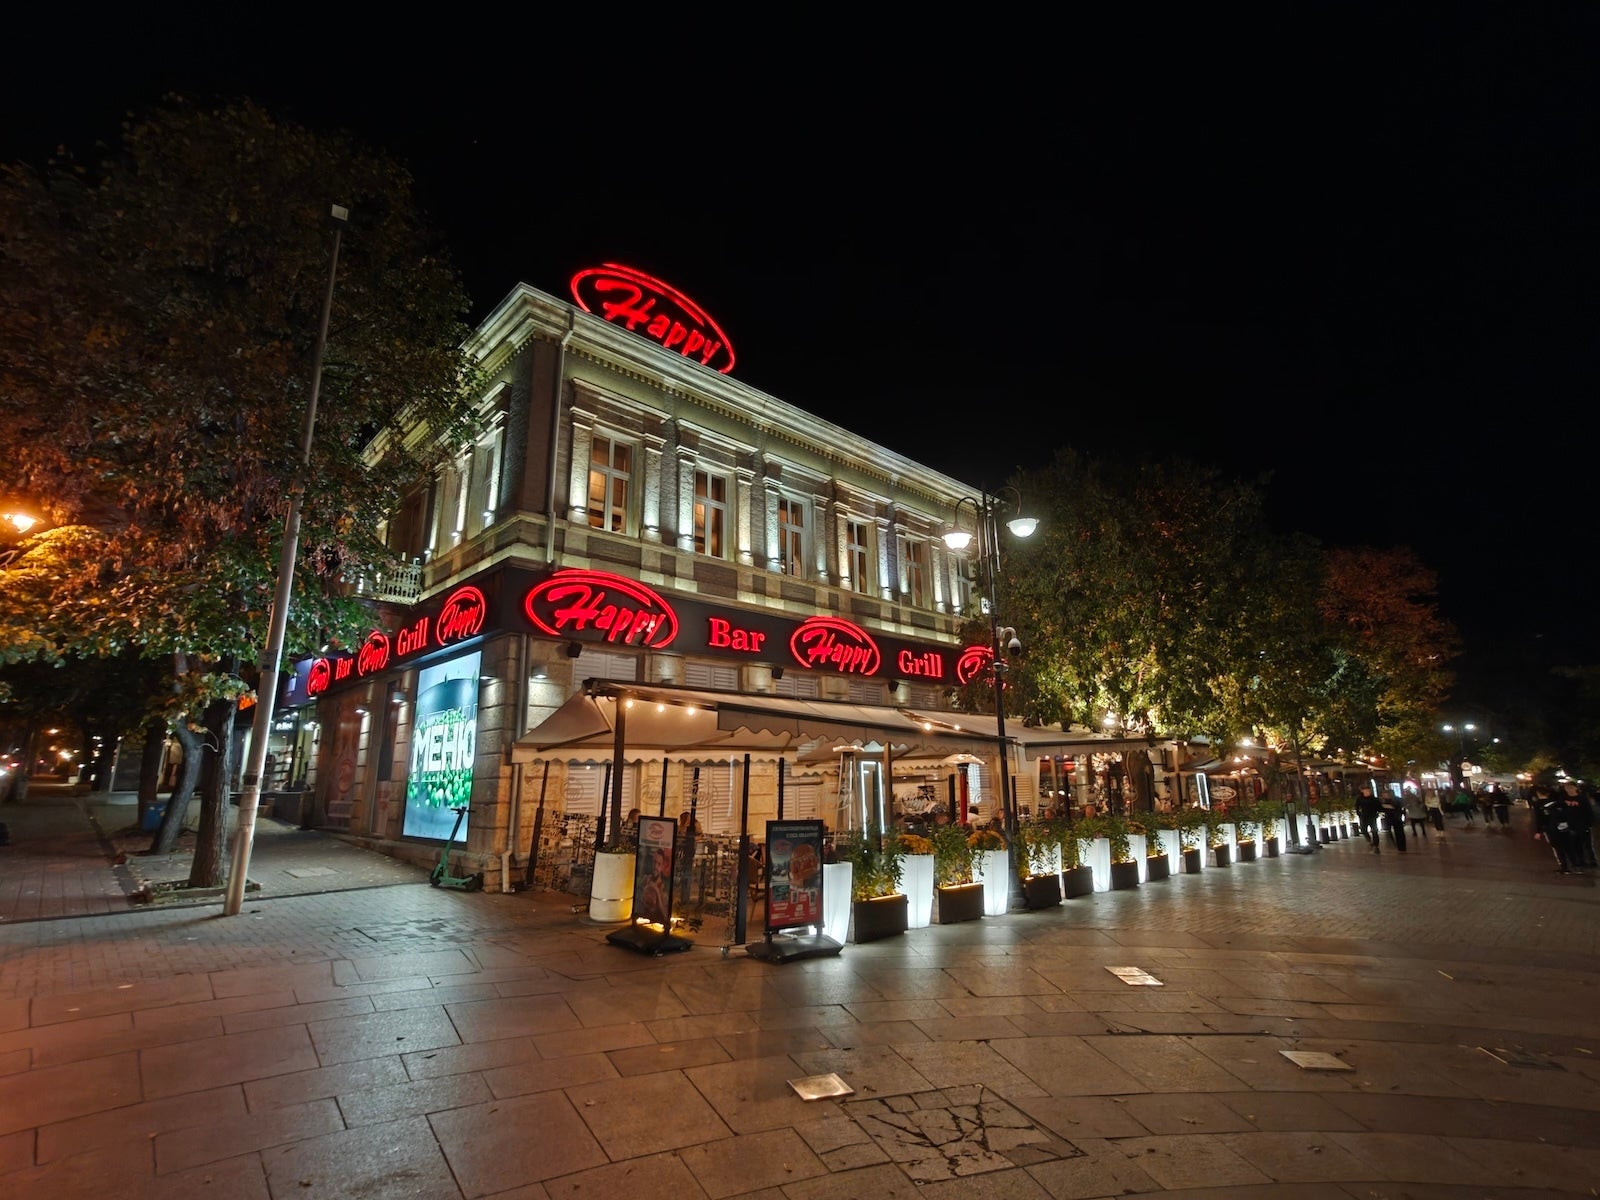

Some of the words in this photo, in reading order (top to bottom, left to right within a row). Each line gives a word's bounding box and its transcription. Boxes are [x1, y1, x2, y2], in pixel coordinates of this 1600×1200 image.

[595, 279, 721, 365] Happy
[335, 657, 353, 680] Bar
[397, 617, 429, 656] Grill
[442, 603, 481, 640] Happy
[547, 584, 667, 645] Happy
[709, 617, 766, 652] Bar
[802, 628, 872, 673] Happy
[899, 650, 942, 677] Grill
[411, 719, 477, 774] МЕНЮ
